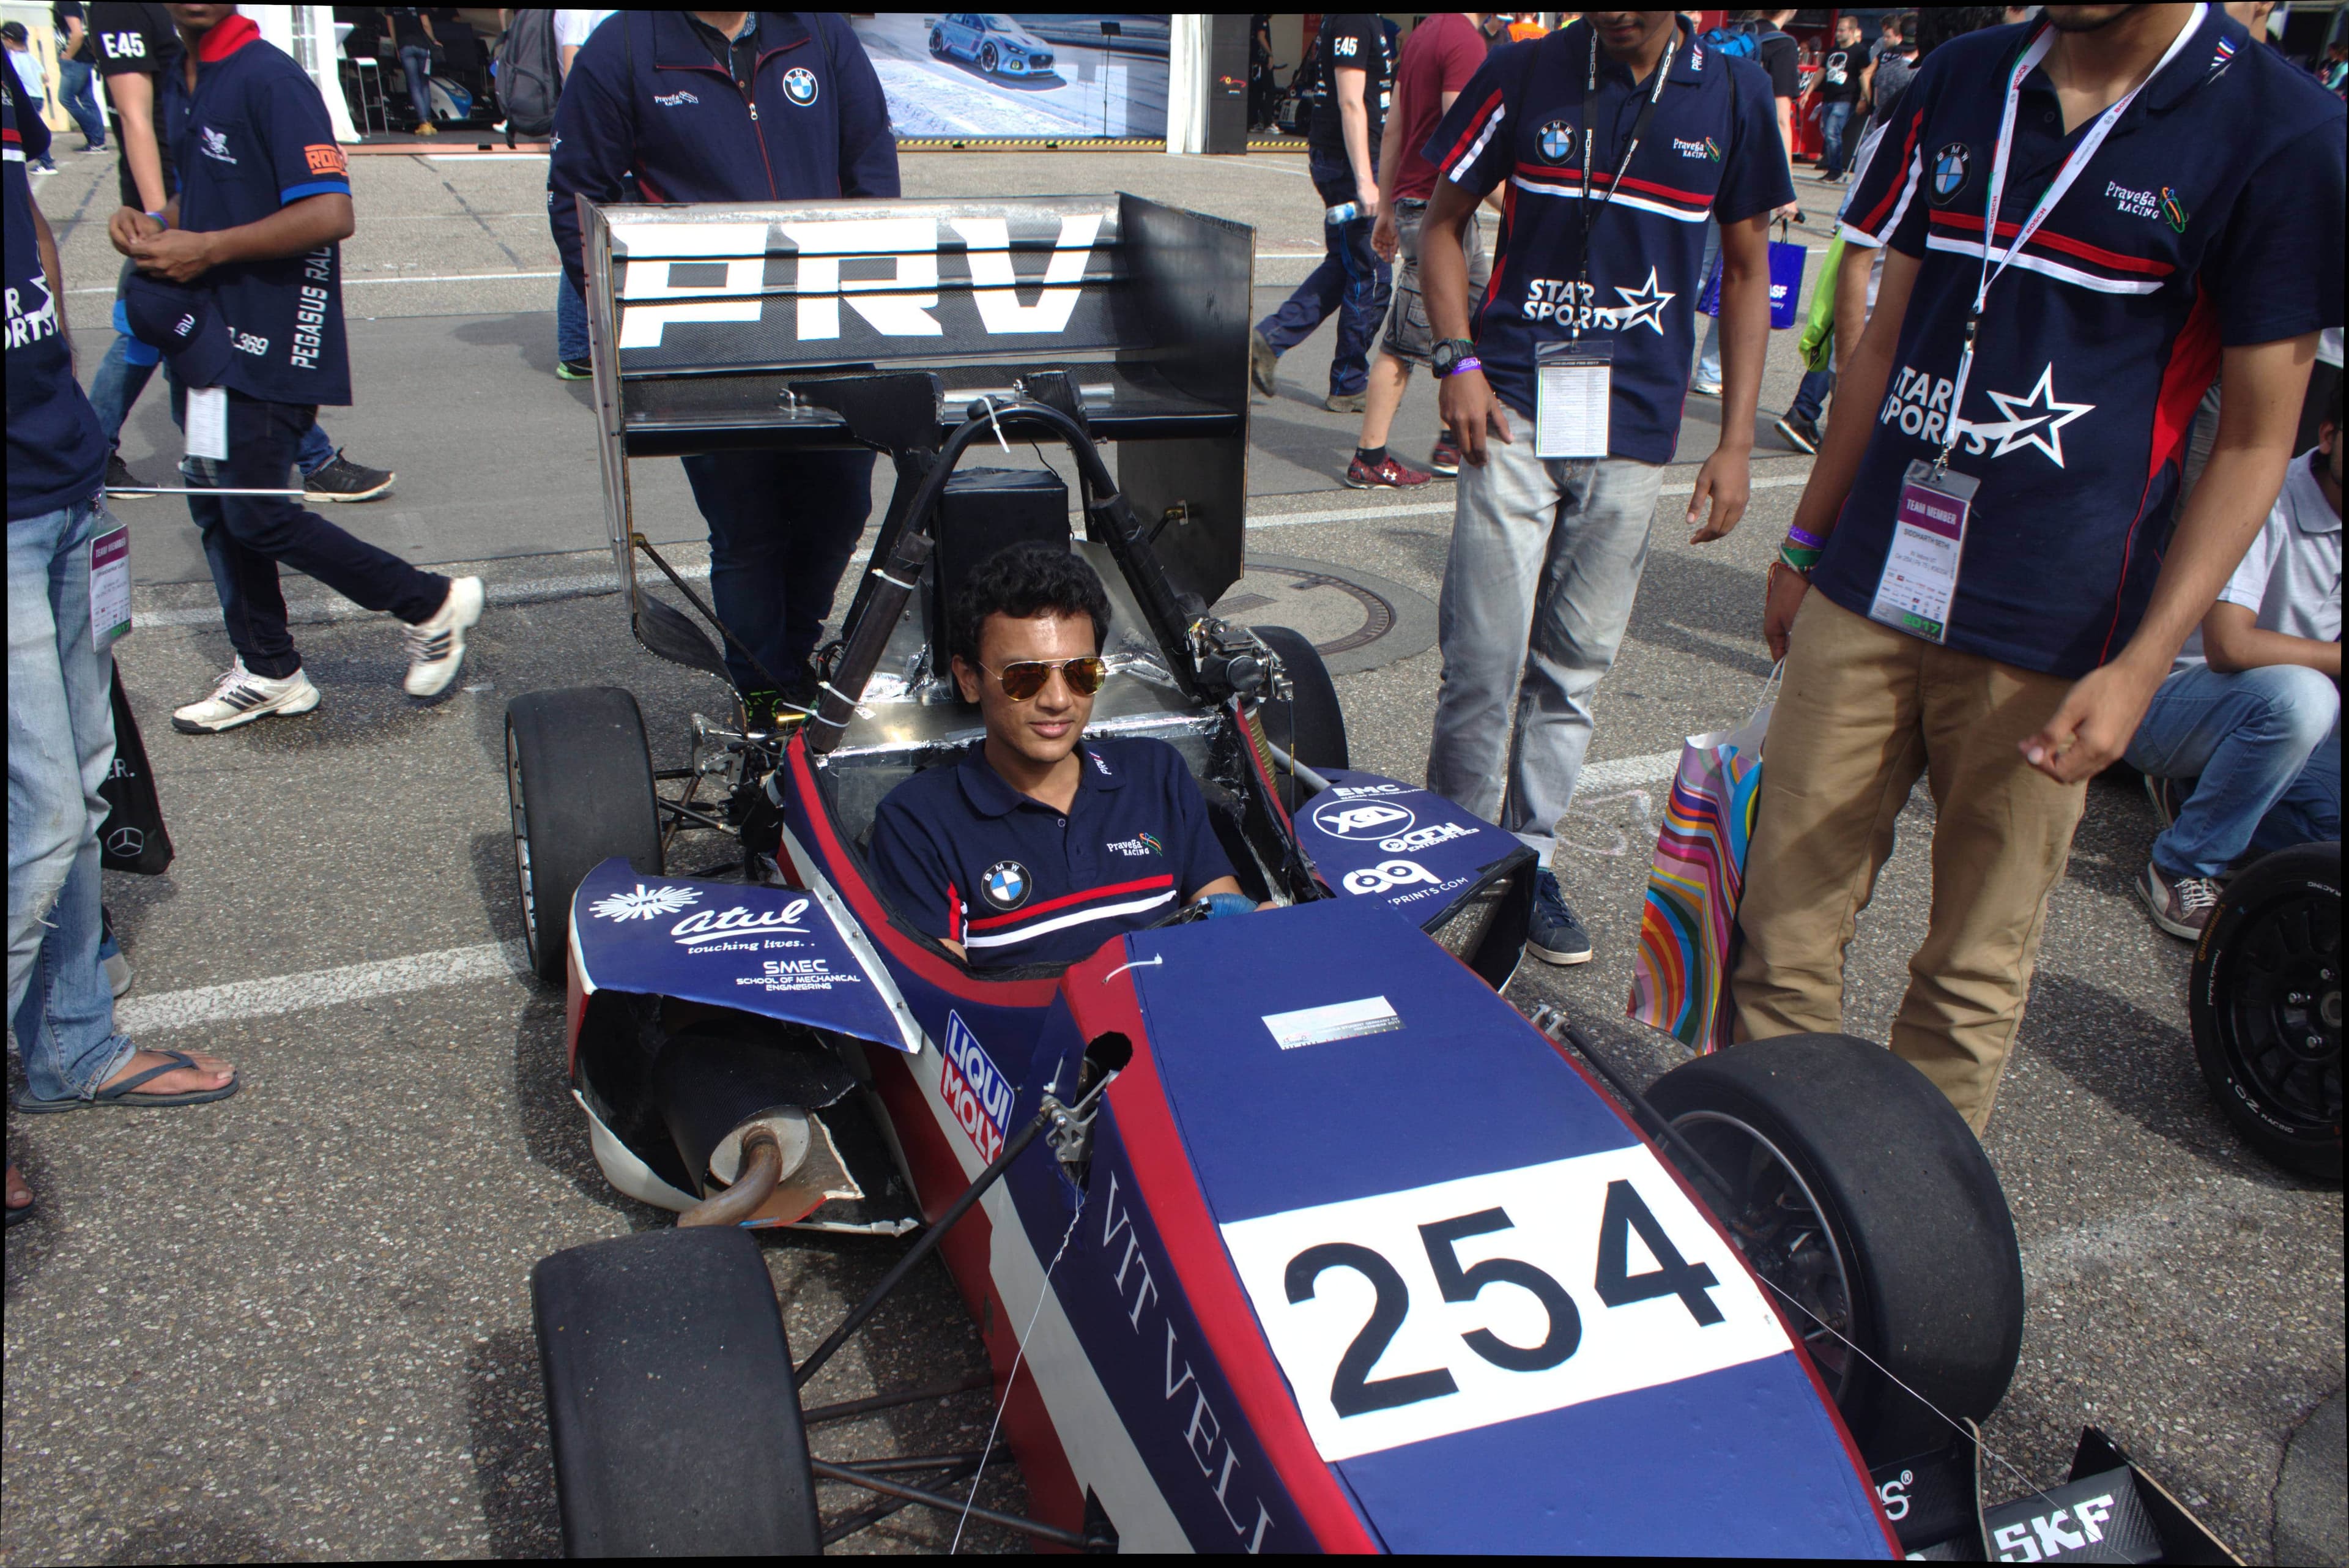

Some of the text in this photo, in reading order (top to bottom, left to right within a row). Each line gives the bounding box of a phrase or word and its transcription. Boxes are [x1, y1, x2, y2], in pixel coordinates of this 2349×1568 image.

[102, 33, 145, 59] E45
[1334, 37, 1357, 56] E45
[1652, 42, 1675, 103] PORSCHE
[1674, 138, 1704, 152] Pravega
[1683, 150, 1707, 159] RACING
[1583, 128, 1592, 195] PORSCHE
[2104, 181, 2156, 206] Pravega
[2026, 207, 2047, 234] BOSCH
[2117, 200, 2160, 219] RACING
[612, 214, 1104, 348] PRV
[1528, 278, 1595, 307] STAR
[1770, 284, 1787, 299] SF
[291, 286, 328, 369] PEGASUS
[1522, 301, 1618, 330] SPORTS
[1894, 365, 1954, 413] TAR
[1880, 393, 1987, 455] PORTS
[1906, 499, 1956, 525] TEAM MEMBER
[1902, 614, 1940, 634] 2017
[1332, 784, 1400, 797] EMC
[1106, 839, 1143, 852] Pravega
[688, 941, 759, 954] touching
[763, 959, 828, 974] SMEC
[766, 983, 832, 991] ENGINEERING
[949, 1019, 1009, 1129] LIQUI
[943, 1061, 1001, 1165] MOLY
[2261, 1113, 2295, 1134] RACING
[1103, 1170, 1158, 1334] VIT
[1284, 1178, 1726, 1419] 254
[1994, 1494, 2114, 1562] SKF
